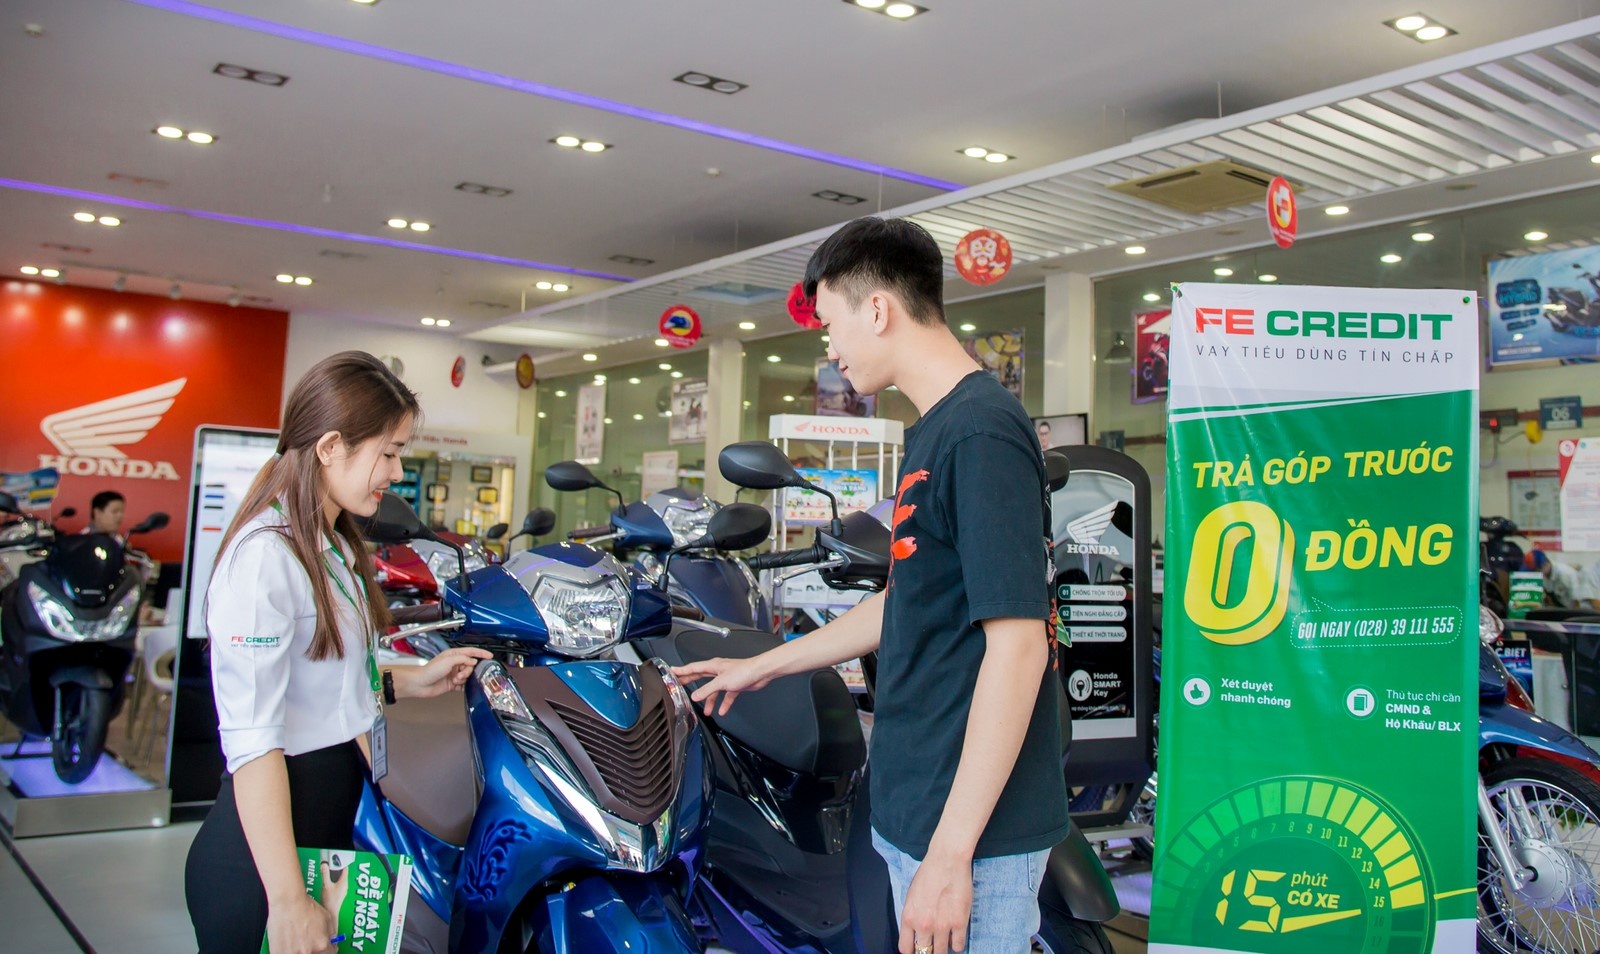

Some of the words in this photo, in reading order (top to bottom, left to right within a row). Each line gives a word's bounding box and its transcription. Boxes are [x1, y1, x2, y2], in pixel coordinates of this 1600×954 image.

[1196, 308, 1255, 335] FE
[1267, 310, 1453, 340] CREDIT
[1196, 345, 1230, 357] VAY
[1296, 346, 1348, 361] DÙNG
[1359, 347, 1391, 362] TÍN
[1551, 408, 1571, 420] 06
[812, 425, 871, 435] HONDA
[37, 454, 181, 481] HONDA
[1193, 454, 1255, 488] TRẢ
[1263, 450, 1332, 486] GÓP
[1344, 441, 1454, 478] TRƯỚC
[1066, 544, 1120, 556] HONDA
[1184, 500, 1296, 646] 0
[1305, 518, 1454, 572] ĐỒNG
[1298, 622, 1317, 641] GỌI
[1320, 620, 1351, 638] NGAY
[1354, 618, 1388, 637] (028)
[1391, 618, 1406, 635] 39
[1409, 617, 1428, 634] 111
[1432, 616, 1455, 633] 555
[231, 635, 245, 643] FE
[1093, 672, 1118, 680] Honda
[1093, 680, 1121, 688] SMART
[1221, 677, 1239, 689] Xét
[1241, 680, 1273, 692] duyệt
[1093, 689, 1108, 698] Key
[1407, 691, 1424, 702] tục
[1220, 692, 1255, 704] nhanh
[1257, 695, 1291, 709] chóng
[1385, 703, 1420, 715] CMND
[1422, 705, 1432, 716] &
[1385, 718, 1401, 730] Hộ
[1438, 721, 1461, 732] BLX
[1270, 822, 1277, 833] 7
[1288, 821, 1296, 833] 8
[1306, 823, 1313, 834] 9
[1320, 827, 1333, 840] 10
[1337, 836, 1349, 848] 11
[1351, 847, 1363, 859] 12
[1361, 860, 1374, 873] 13
[356, 862, 371, 899] VỌT
[1368, 877, 1381, 889] 14
[368, 876, 385, 900] ĐỀ
[1215, 869, 1286, 933] 15
[1291, 871, 1328, 887] phút
[1287, 889, 1313, 906] CÓ
[1315, 893, 1340, 909] XE
[1373, 895, 1386, 908] 15
[352, 900, 368, 952] NGAY
[365, 902, 380, 943] MÁY
